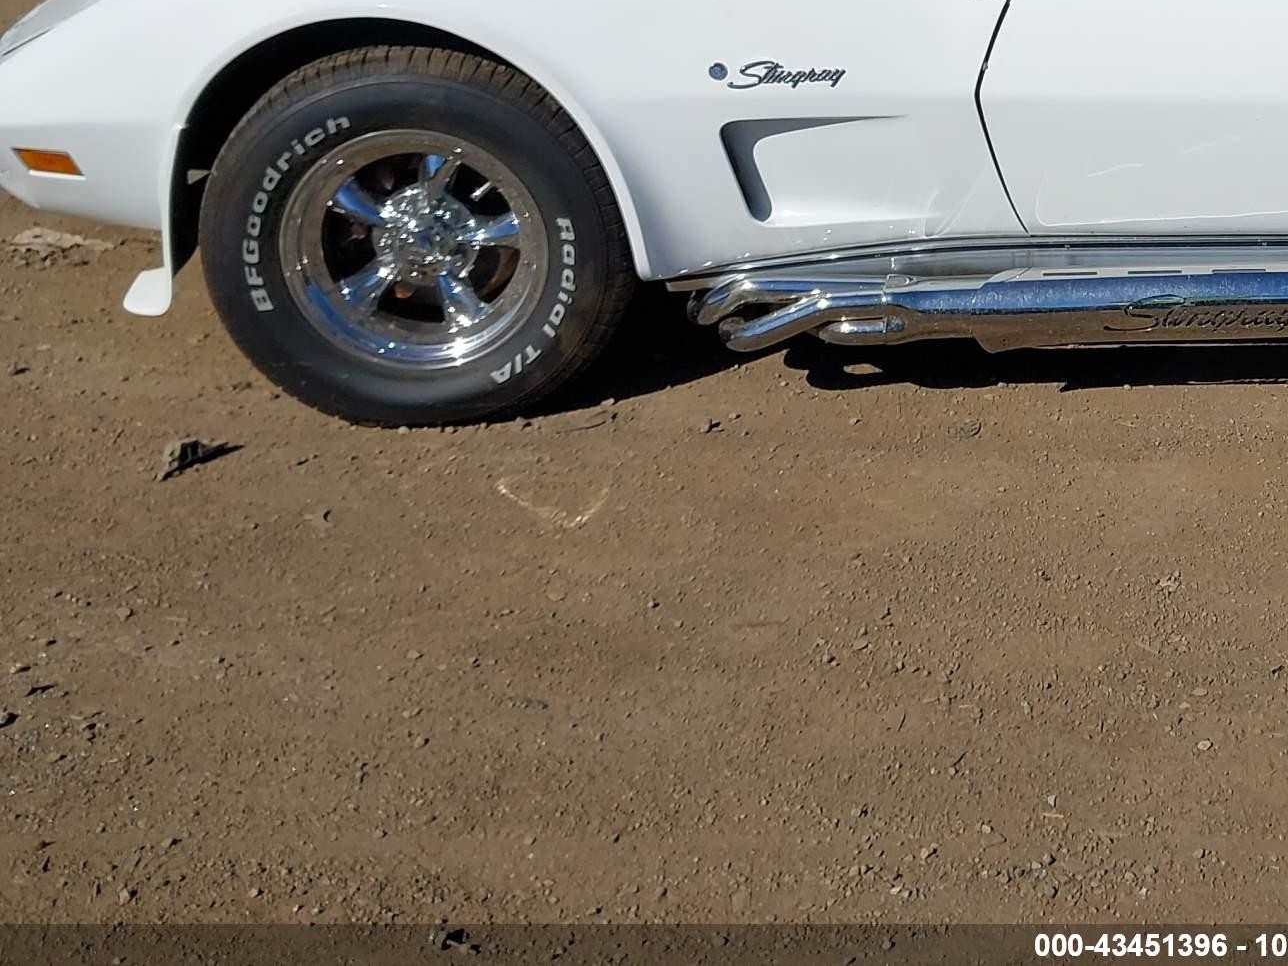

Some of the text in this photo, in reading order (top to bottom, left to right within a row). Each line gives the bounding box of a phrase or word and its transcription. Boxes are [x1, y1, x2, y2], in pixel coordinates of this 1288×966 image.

[727, 60, 846, 89] Stingray
[240, 114, 352, 313] BFGoodrich
[488, 217, 577, 386] Radial T/A
